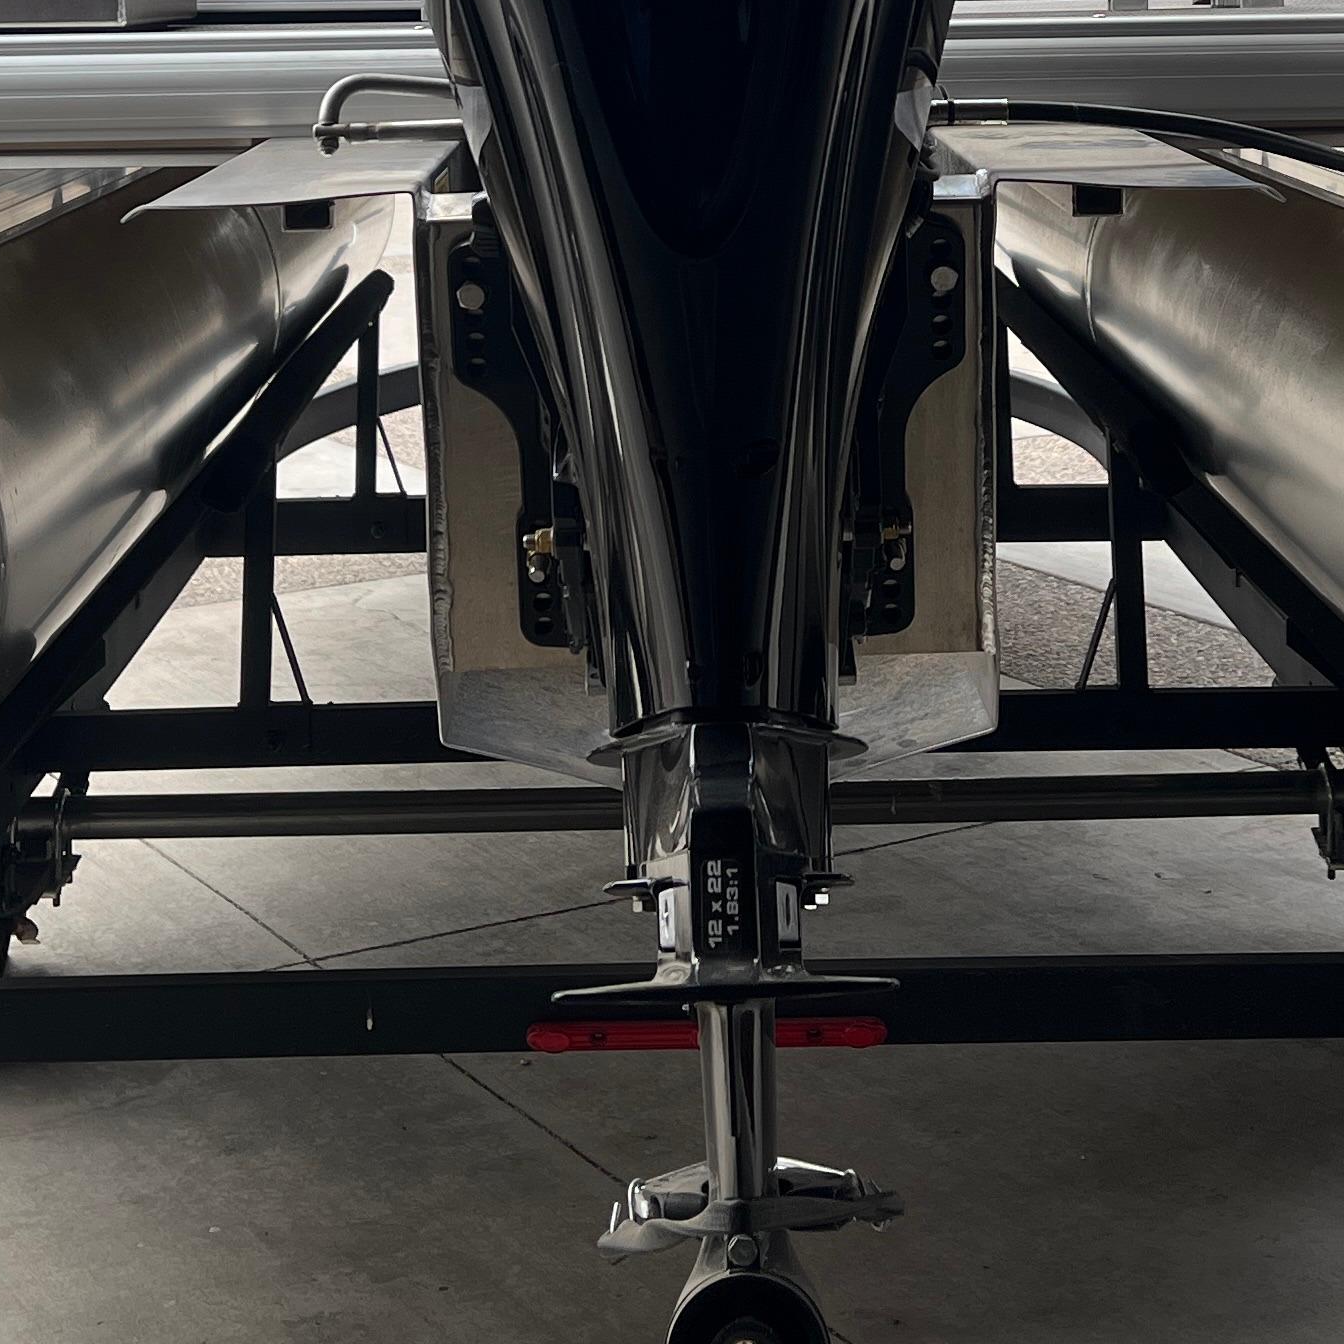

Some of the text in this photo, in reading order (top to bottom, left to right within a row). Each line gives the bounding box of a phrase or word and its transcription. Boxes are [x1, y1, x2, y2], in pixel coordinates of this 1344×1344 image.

[707, 859, 723, 949] 12 x 22
[725, 867, 740, 936] 1.83:1
